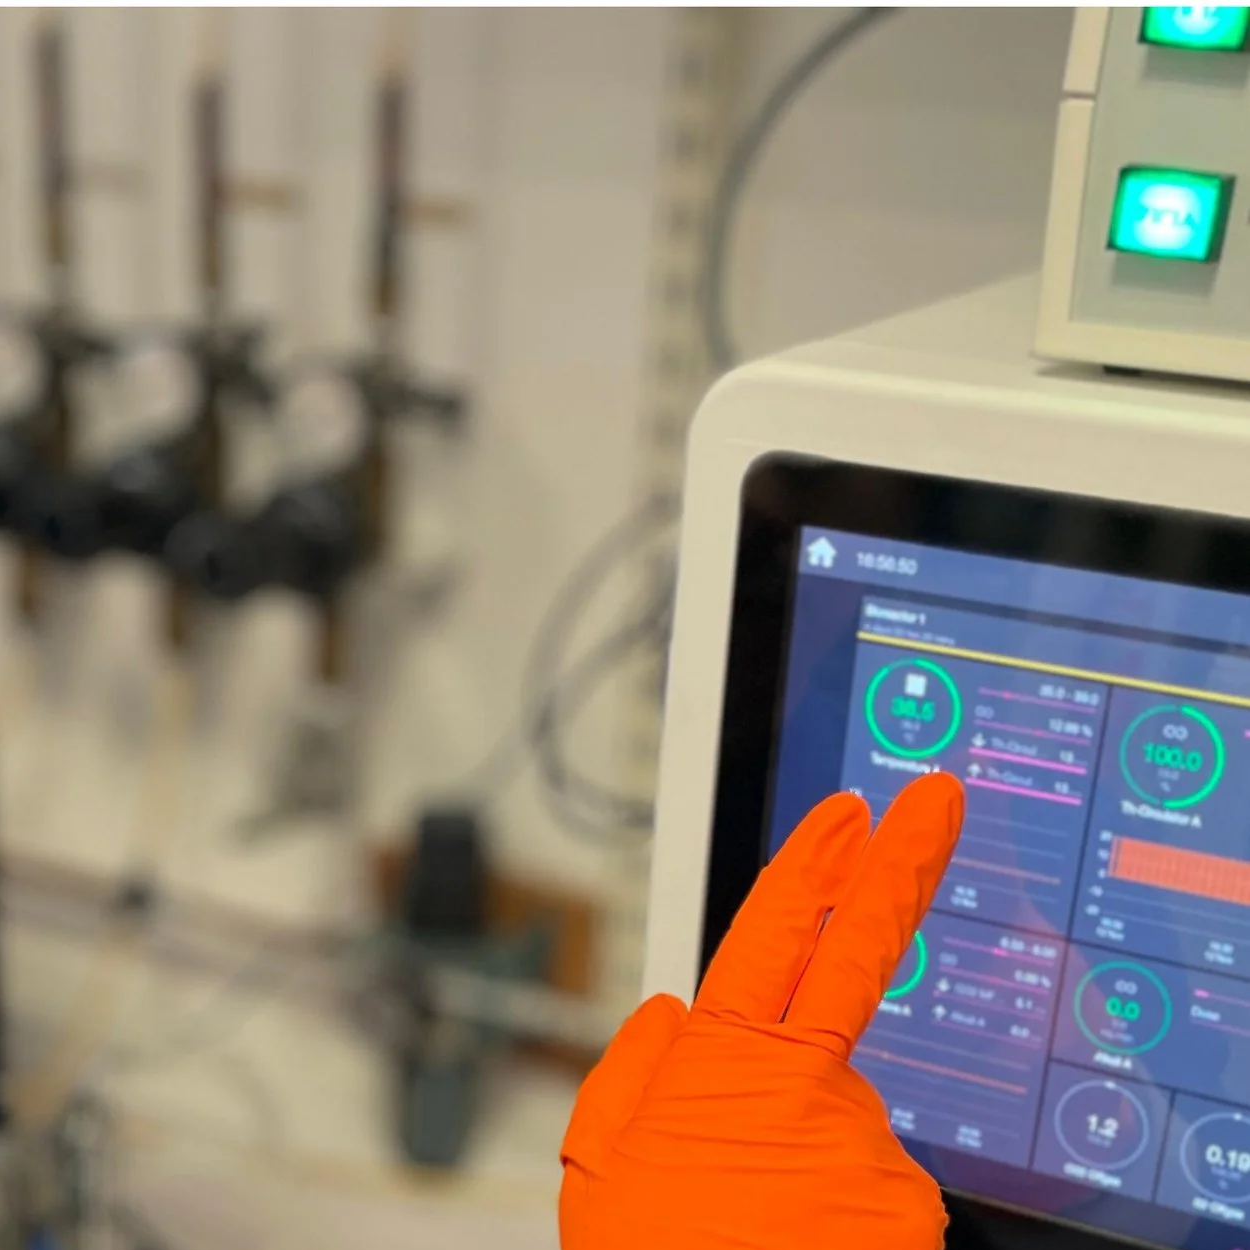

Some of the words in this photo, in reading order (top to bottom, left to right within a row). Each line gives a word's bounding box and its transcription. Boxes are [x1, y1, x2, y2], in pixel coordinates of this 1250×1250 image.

[1143, 741, 1203, 772] 100.0
[1106, 996, 1140, 1021] 0.0
[1087, 1113, 1120, 1139] 1.2
